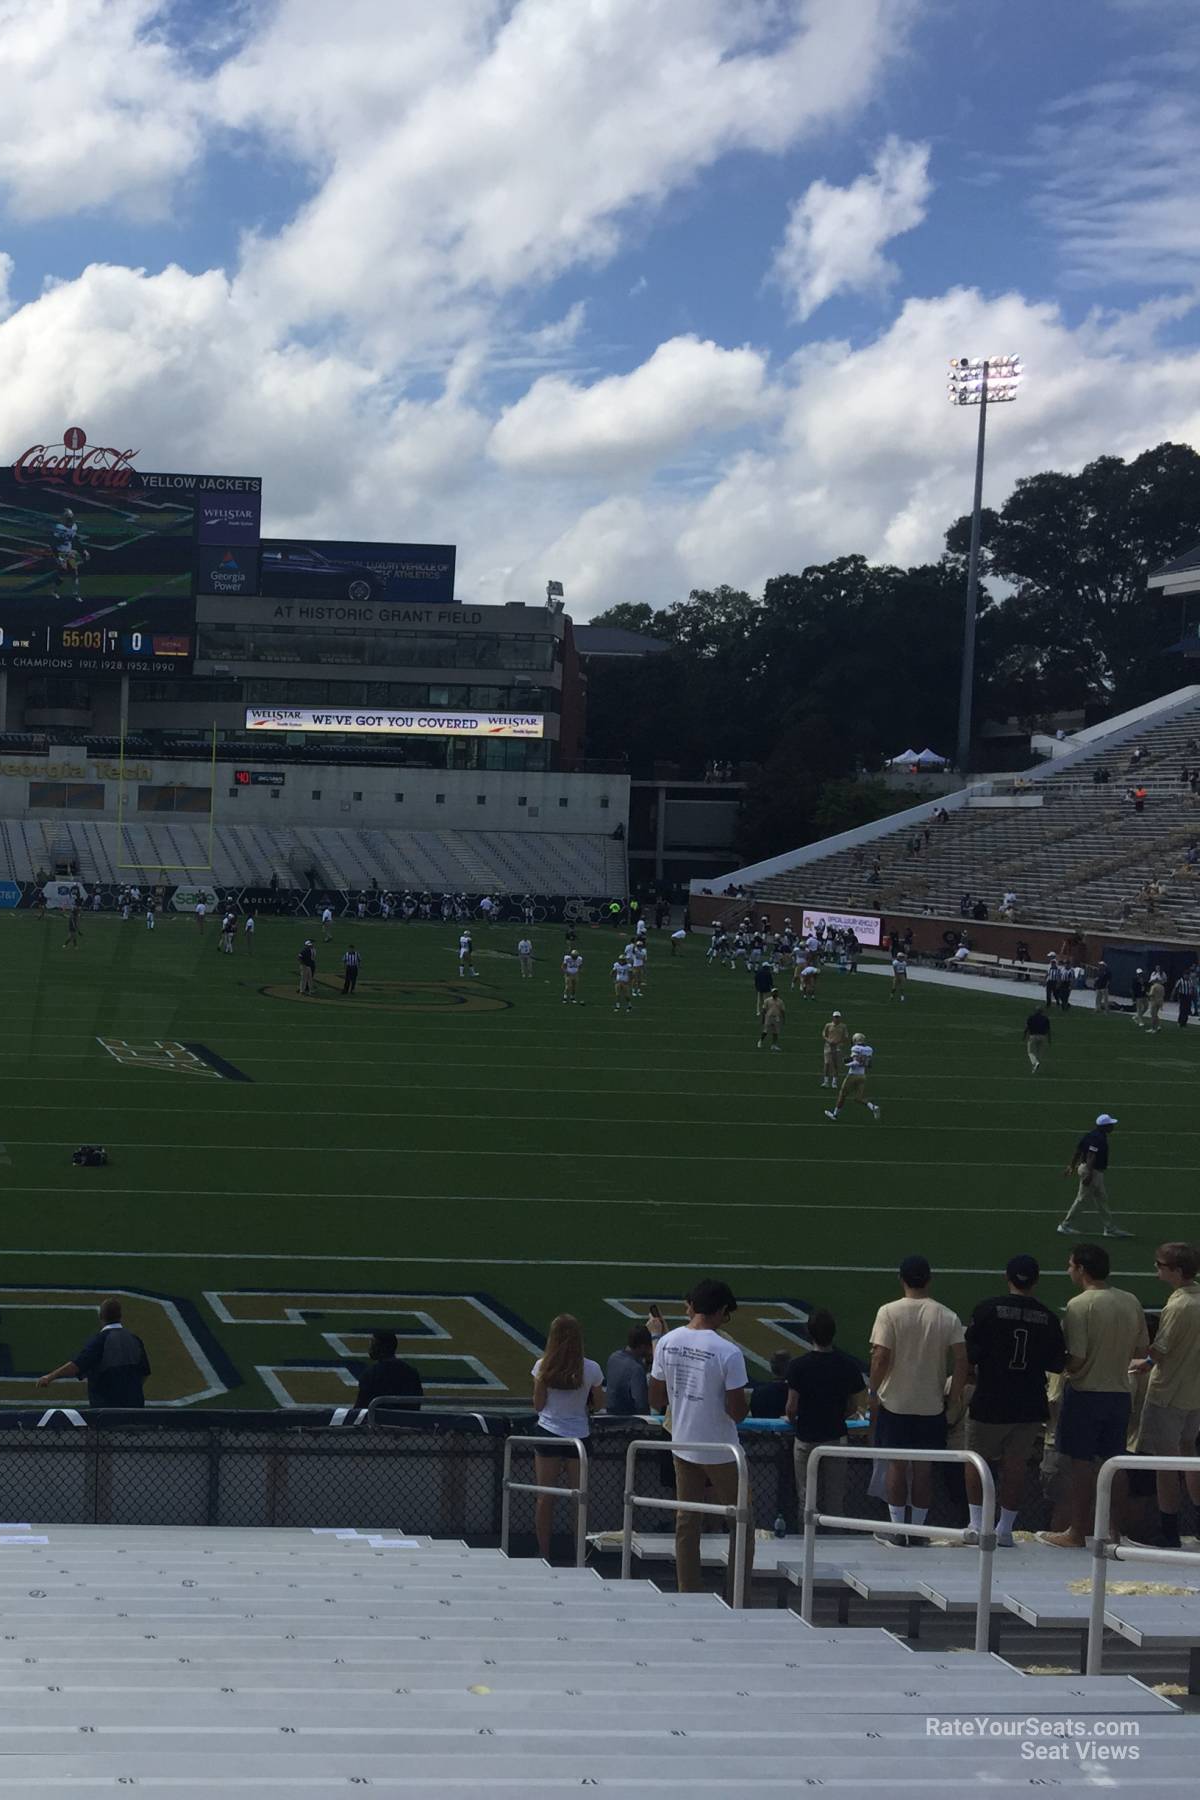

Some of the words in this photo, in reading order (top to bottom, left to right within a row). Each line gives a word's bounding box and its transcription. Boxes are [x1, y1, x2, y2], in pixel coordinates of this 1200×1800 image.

[13, 444, 141, 488] Coca-Cola
[141, 476, 196, 488] YELLOW
[199, 478, 260, 491] JACKETS
[210, 571, 246, 583] Georgia
[214, 581, 242, 591] Power
[274, 605, 291, 619] AT
[299, 607, 372, 622] HISTORIC
[379, 609, 432, 623] GRANT
[438, 610, 482, 625] FIELD
[62, 630, 101, 648] 55:03
[132, 632, 142, 651] 0
[13, 657, 73, 668] CHAMPIONS
[152, 662, 175, 672] 1990
[312, 714, 352, 726] WE'VE
[356, 716, 383, 727] GOT
[388, 717, 413, 728] YOU
[417, 718, 478, 729] COVERED
[94, 761, 152, 781] Tech
[1008, 1328, 1029, 1370] 1
